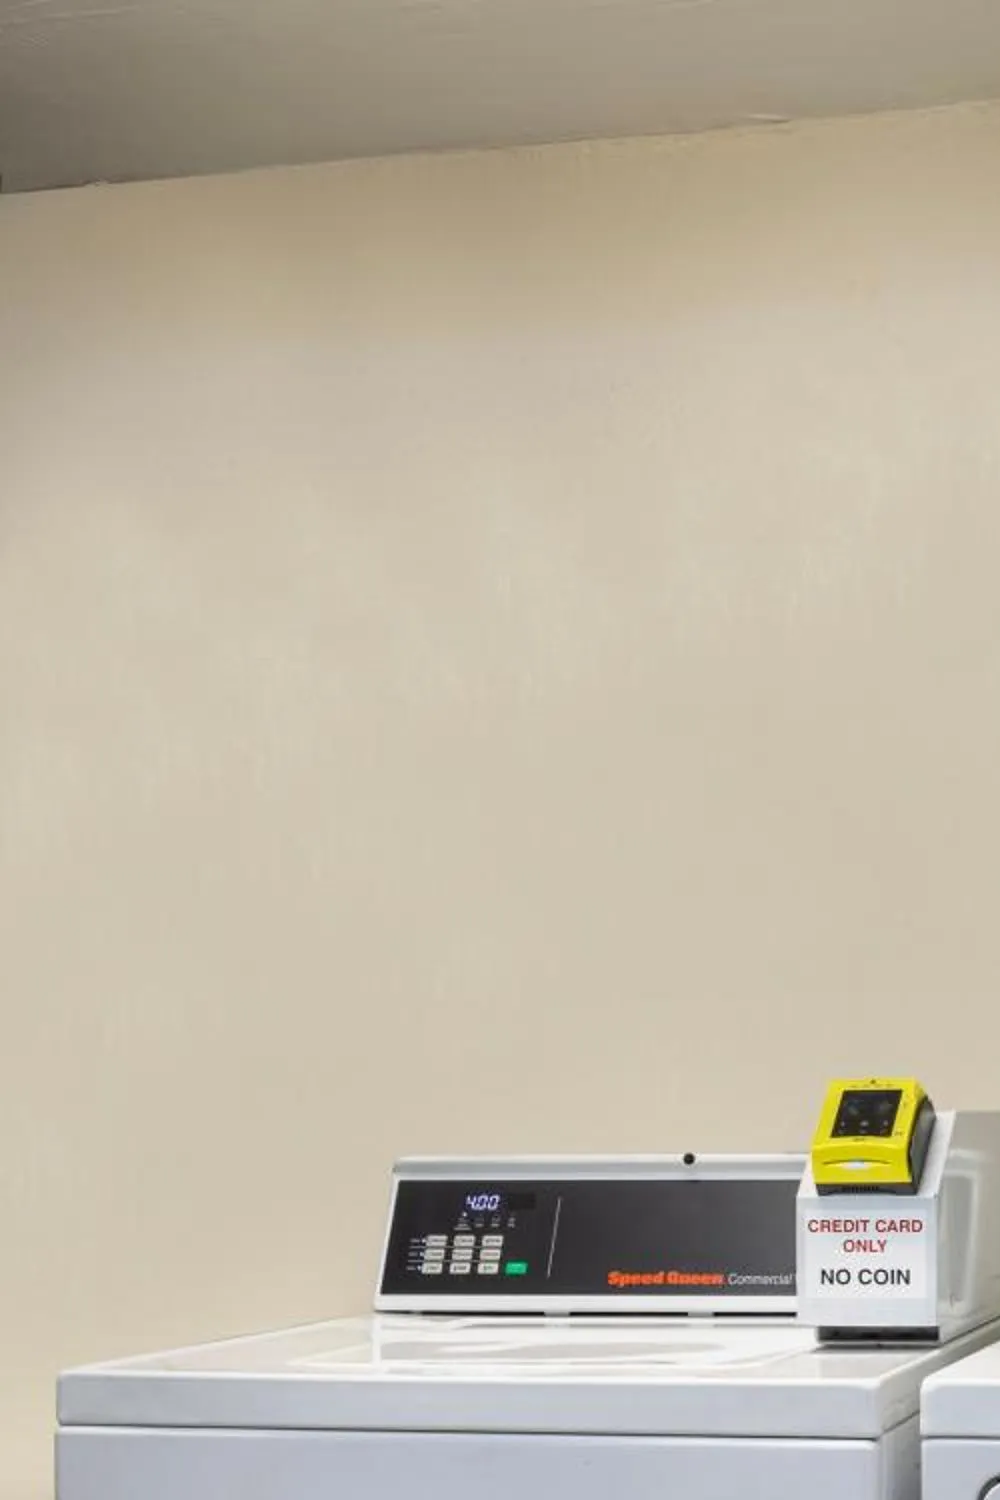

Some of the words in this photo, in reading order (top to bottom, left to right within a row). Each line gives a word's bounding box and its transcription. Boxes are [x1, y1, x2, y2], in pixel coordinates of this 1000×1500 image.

[807, 1219, 870, 1232] CREDIT
[875, 1219, 923, 1232] CARD
[843, 1239, 887, 1253] ONLY
[607, 1271, 664, 1288] Speed
[667, 1271, 724, 1286] Queen
[820, 1268, 851, 1285] NO
[857, 1268, 911, 1285] COIN
